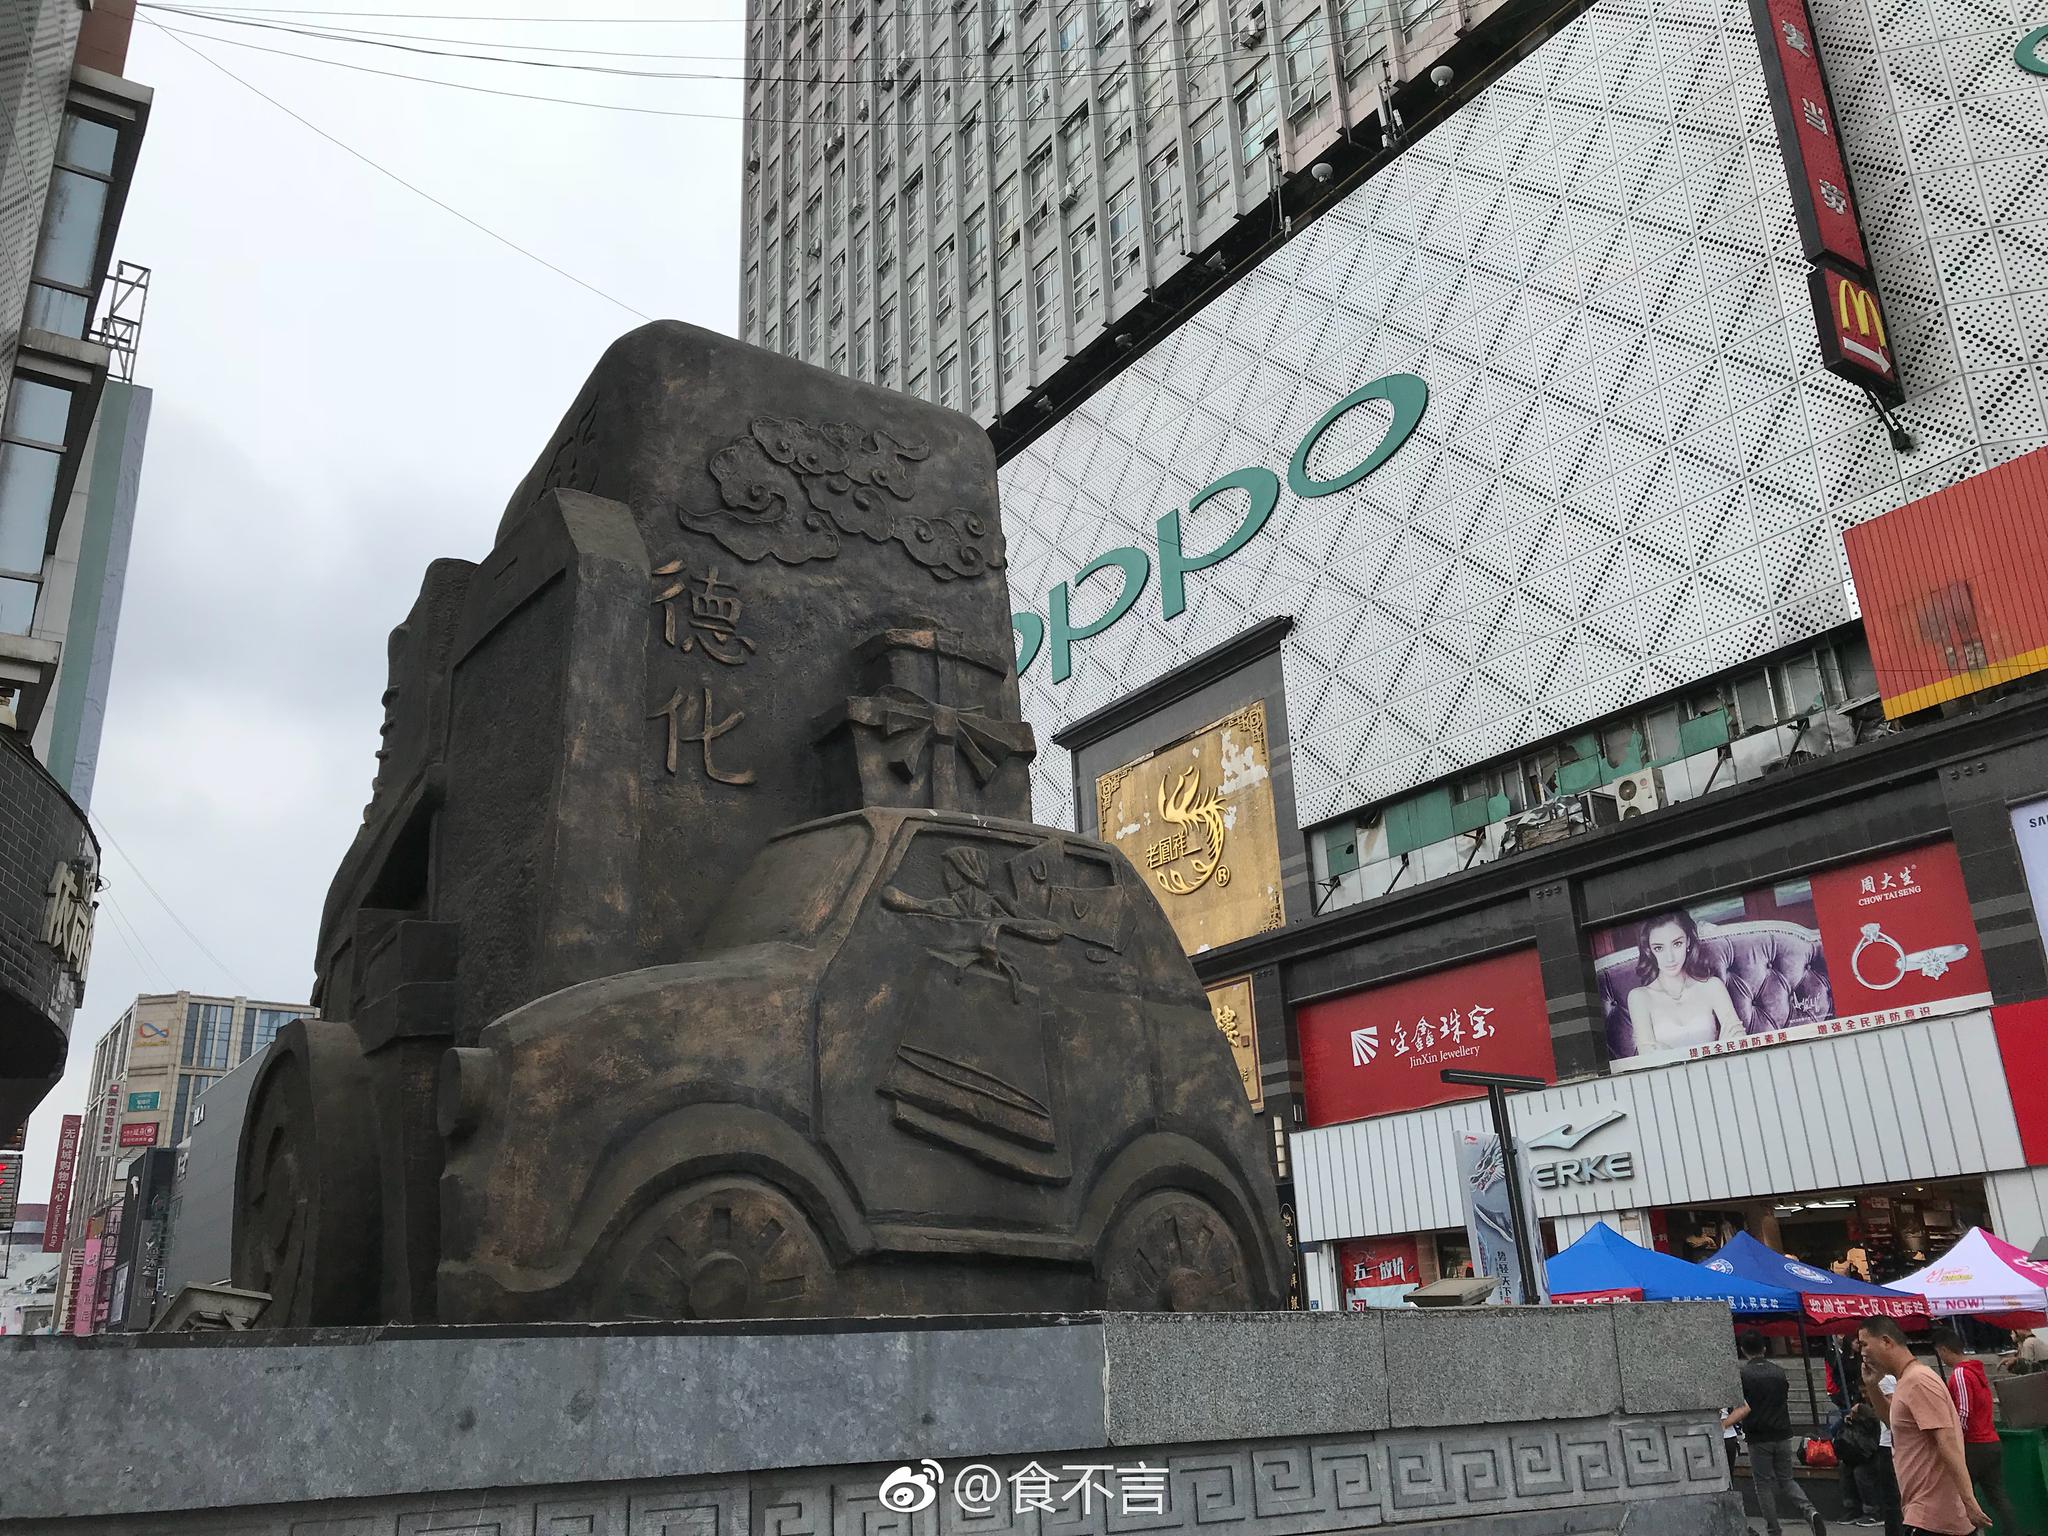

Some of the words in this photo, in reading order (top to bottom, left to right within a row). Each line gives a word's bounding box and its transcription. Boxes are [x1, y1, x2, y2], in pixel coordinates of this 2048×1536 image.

[1860, 866, 1914, 894] 周大生
[1390, 1004, 1495, 1057] 金鑫珠宝
[1689, 1031, 1788, 1059] 提高全民消防素质
[1817, 1006, 1932, 1035] 增强全民消防意识
[1409, 1053, 1438, 1068] JinXin
[1440, 1045, 1480, 1062] Jewellery
[54, 1128, 77, 1202] 无限城购物中心
[1530, 1151, 1634, 1189] ERKE
